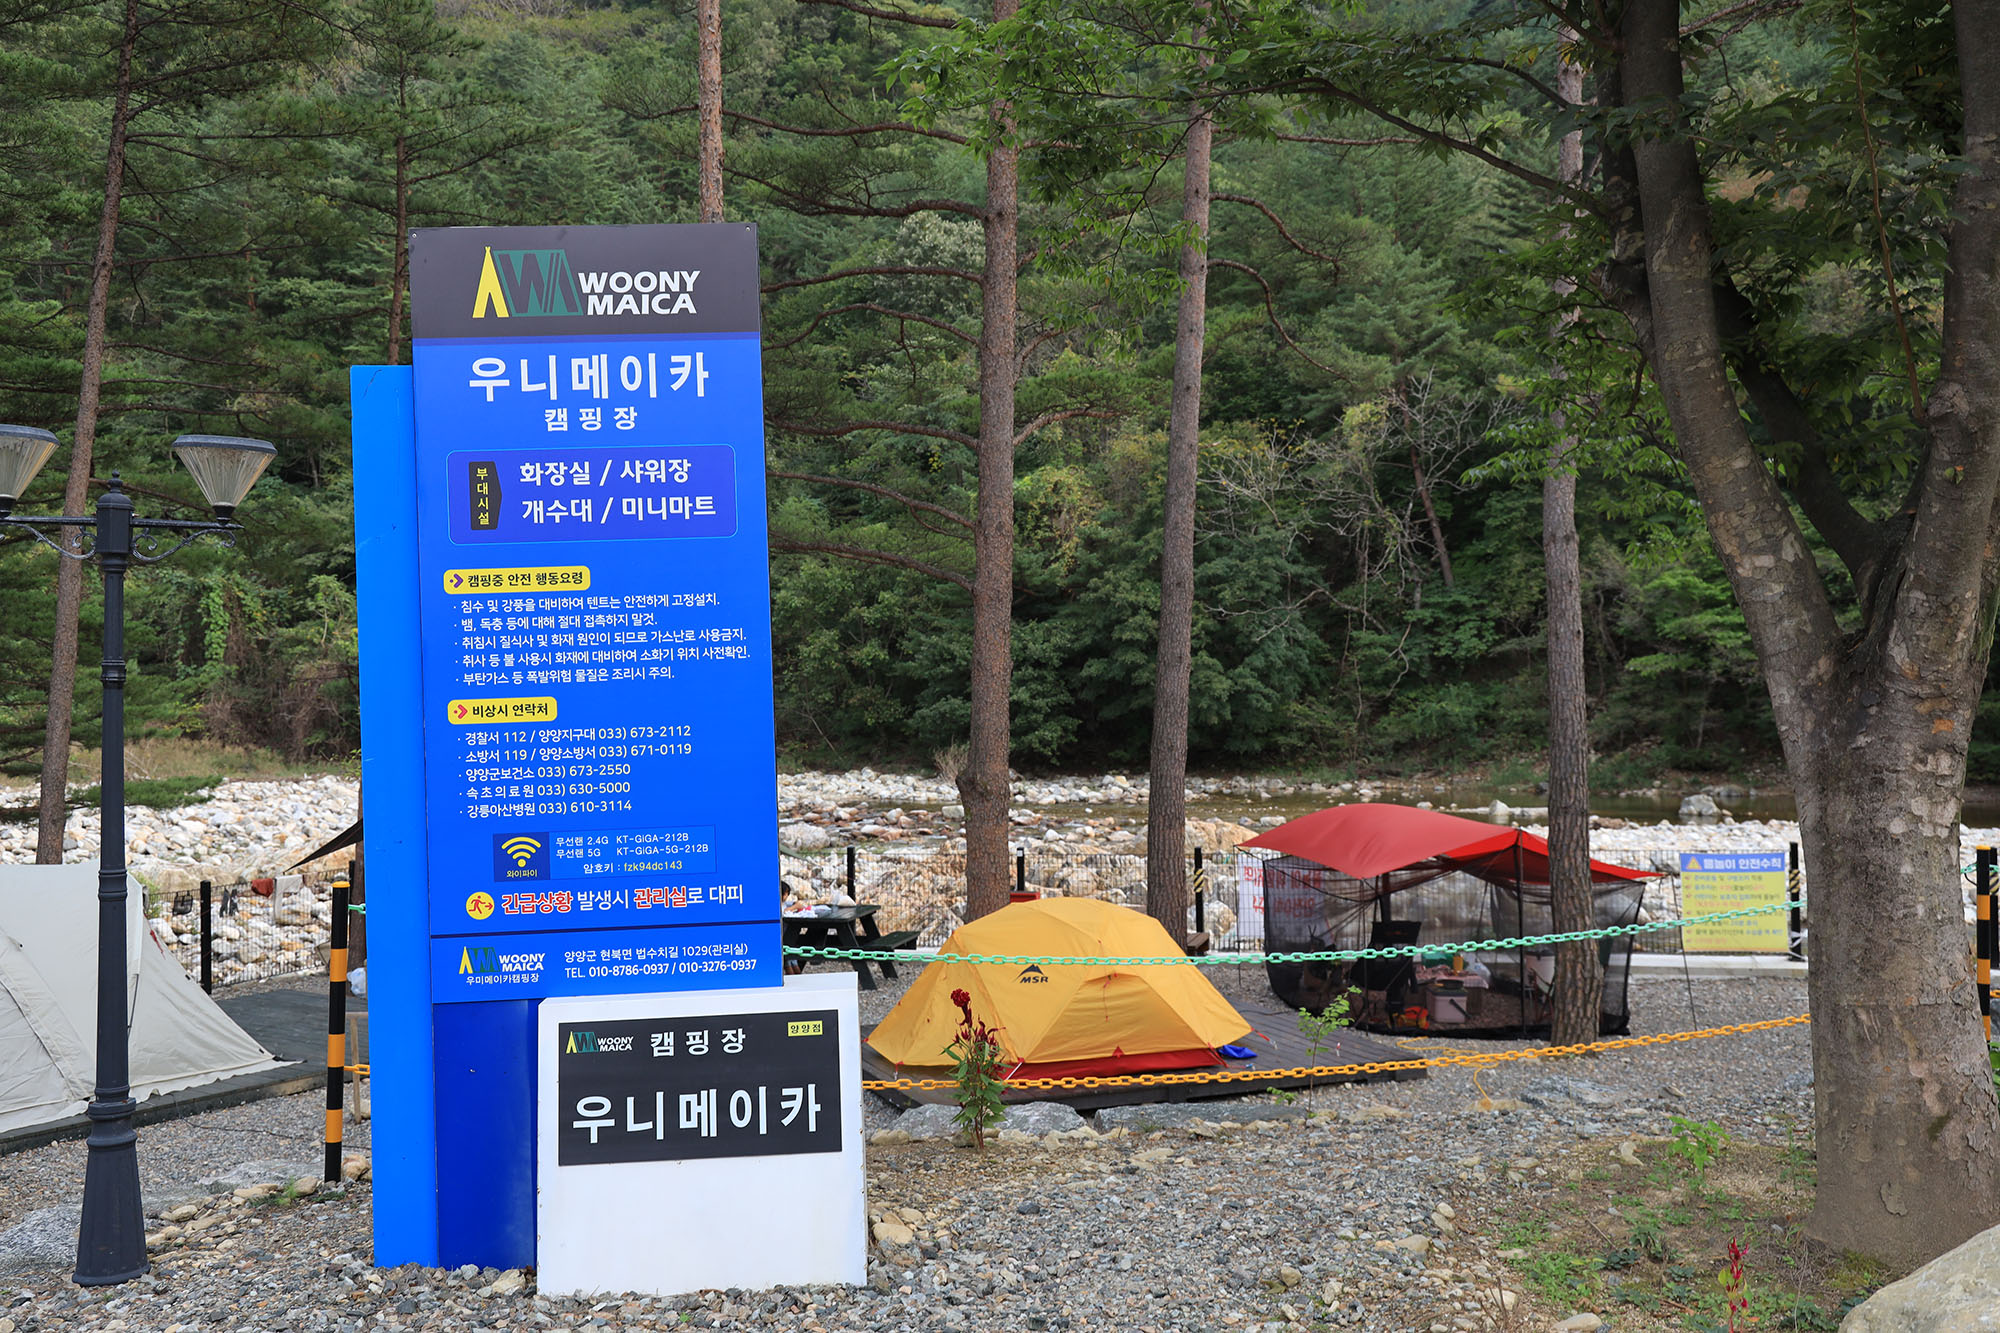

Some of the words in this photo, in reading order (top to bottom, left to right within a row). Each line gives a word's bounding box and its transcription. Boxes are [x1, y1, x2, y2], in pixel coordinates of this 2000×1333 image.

[578, 271, 700, 293] WOONY
[588, 294, 697, 315] MAICA
[470, 352, 709, 401] 우니메이카
[545, 407, 637, 431] 캠핑장
[520, 462, 590, 486] 화장실
[620, 459, 691, 483] 샤워장
[477, 468, 489, 524] 부대시설
[522, 499, 592, 523] 개수대
[622, 496, 716, 520] 미니마트
[467, 573, 504, 588] 캠핑중
[507, 572, 532, 587] 안전
[535, 571, 583, 586] 행동요령
[460, 599, 485, 614] 침수
[487, 599, 499, 613] 및
[501, 598, 537, 613] 강풍을
[538, 596, 584, 611] 대비하여
[586, 595, 622, 610] 텐트는
[623, 593, 669, 609] 안전하게
[671, 592, 720, 608] 고정설치.
[461, 618, 477, 632] 뱀,
[479, 617, 504, 632] 독충
[505, 616, 529, 631] 등에
[531, 615, 555, 630] 대해
[557, 614, 581, 629] 절대
[583, 613, 629, 628] 접촉하지
[631, 612, 658, 627] 말것.
[461, 635, 497, 650] 취침시
[499, 634, 535, 649] 질식사
[536, 633, 548, 648] 및
[550, 632, 575, 647] 화재
[576, 631, 611, 647] 원인이
[613, 631, 649, 645] 되므로
[650, 629, 697, 644] 가스난로
[698, 627, 747, 643] 사용금지.
[462, 653, 487, 668] 취사
[488, 653, 501, 668] 등
[502, 652, 516, 667] 불
[517, 651, 552, 667] 사용시
[554, 650, 590, 665] 화재에
[591, 648, 637, 664] 대비하여
[639, 647, 674, 662] 소화기
[676, 647, 700, 661] 위치
[702, 645, 751, 660] 사전확인.
[462, 671, 510, 686] 부탄가스
[511, 671, 524, 685] 등
[526, 669, 572, 684] 폭발위험
[574, 668, 610, 683] 물질은
[611, 666, 646, 681] 조리시
[648, 665, 675, 680] 주의.
[472, 703, 508, 718] 비상시
[512, 702, 548, 717] 연락처
[465, 731, 500, 746] 경찰서
[503, 730, 527, 743] 112
[538, 727, 596, 744] 양양지구대
[598, 726, 627, 741] 033)
[630, 725, 691, 739] 673-2112
[465, 749, 500, 764] 소방서
[504, 749, 528, 761] 119
[538, 745, 596, 762] 양양소방서
[598, 744, 628, 759] 033)
[630, 743, 692, 757] 671-0119
[465, 766, 536, 783] 양양군보건소
[537, 765, 566, 779] 033)
[569, 763, 631, 777] 673-2550
[466, 784, 534, 800] 속초의료원
[537, 783, 566, 797] 033)
[569, 781, 631, 795] 630-5000
[467, 802, 536, 819] 강릉아산병원
[538, 801, 567, 815] 033)
[570, 799, 632, 813] 610-3114
[555, 836, 584, 847] 무선랜
[586, 835, 609, 846] 2.4G
[556, 848, 584, 859] 무선랜
[587, 847, 601, 858] 5G
[506, 869, 538, 879] 와이파이
[583, 862, 614, 875] 암호키
[623, 859, 683, 872] fzk94dc143
[501, 891, 573, 915] 긴급상황
[578, 889, 628, 911] 발생시
[633, 886, 704, 909] 관리실로
[710, 884, 743, 904] 대피
[498, 953, 546, 963] WOONY
[564, 950, 597, 964] 양양군
[599, 948, 633, 962] 현북면
[635, 945, 679, 960] 법수치길
[682, 943, 749, 957] 1029(관리실)
[501, 961, 545, 972] MAICA
[564, 967, 586, 979] TEL.
[588, 962, 670, 978] 010-8786-0937
[678, 958, 757, 974] 010-3276-0937
[1019, 975, 1049, 984] MSR
[790, 1023, 821, 1035] 양양점
[597, 1036, 634, 1046] WOONY
[597, 1043, 633, 1052] MAICA
[651, 1028, 745, 1057] 캠핑장
[573, 1084, 821, 1143] 우니메이카
